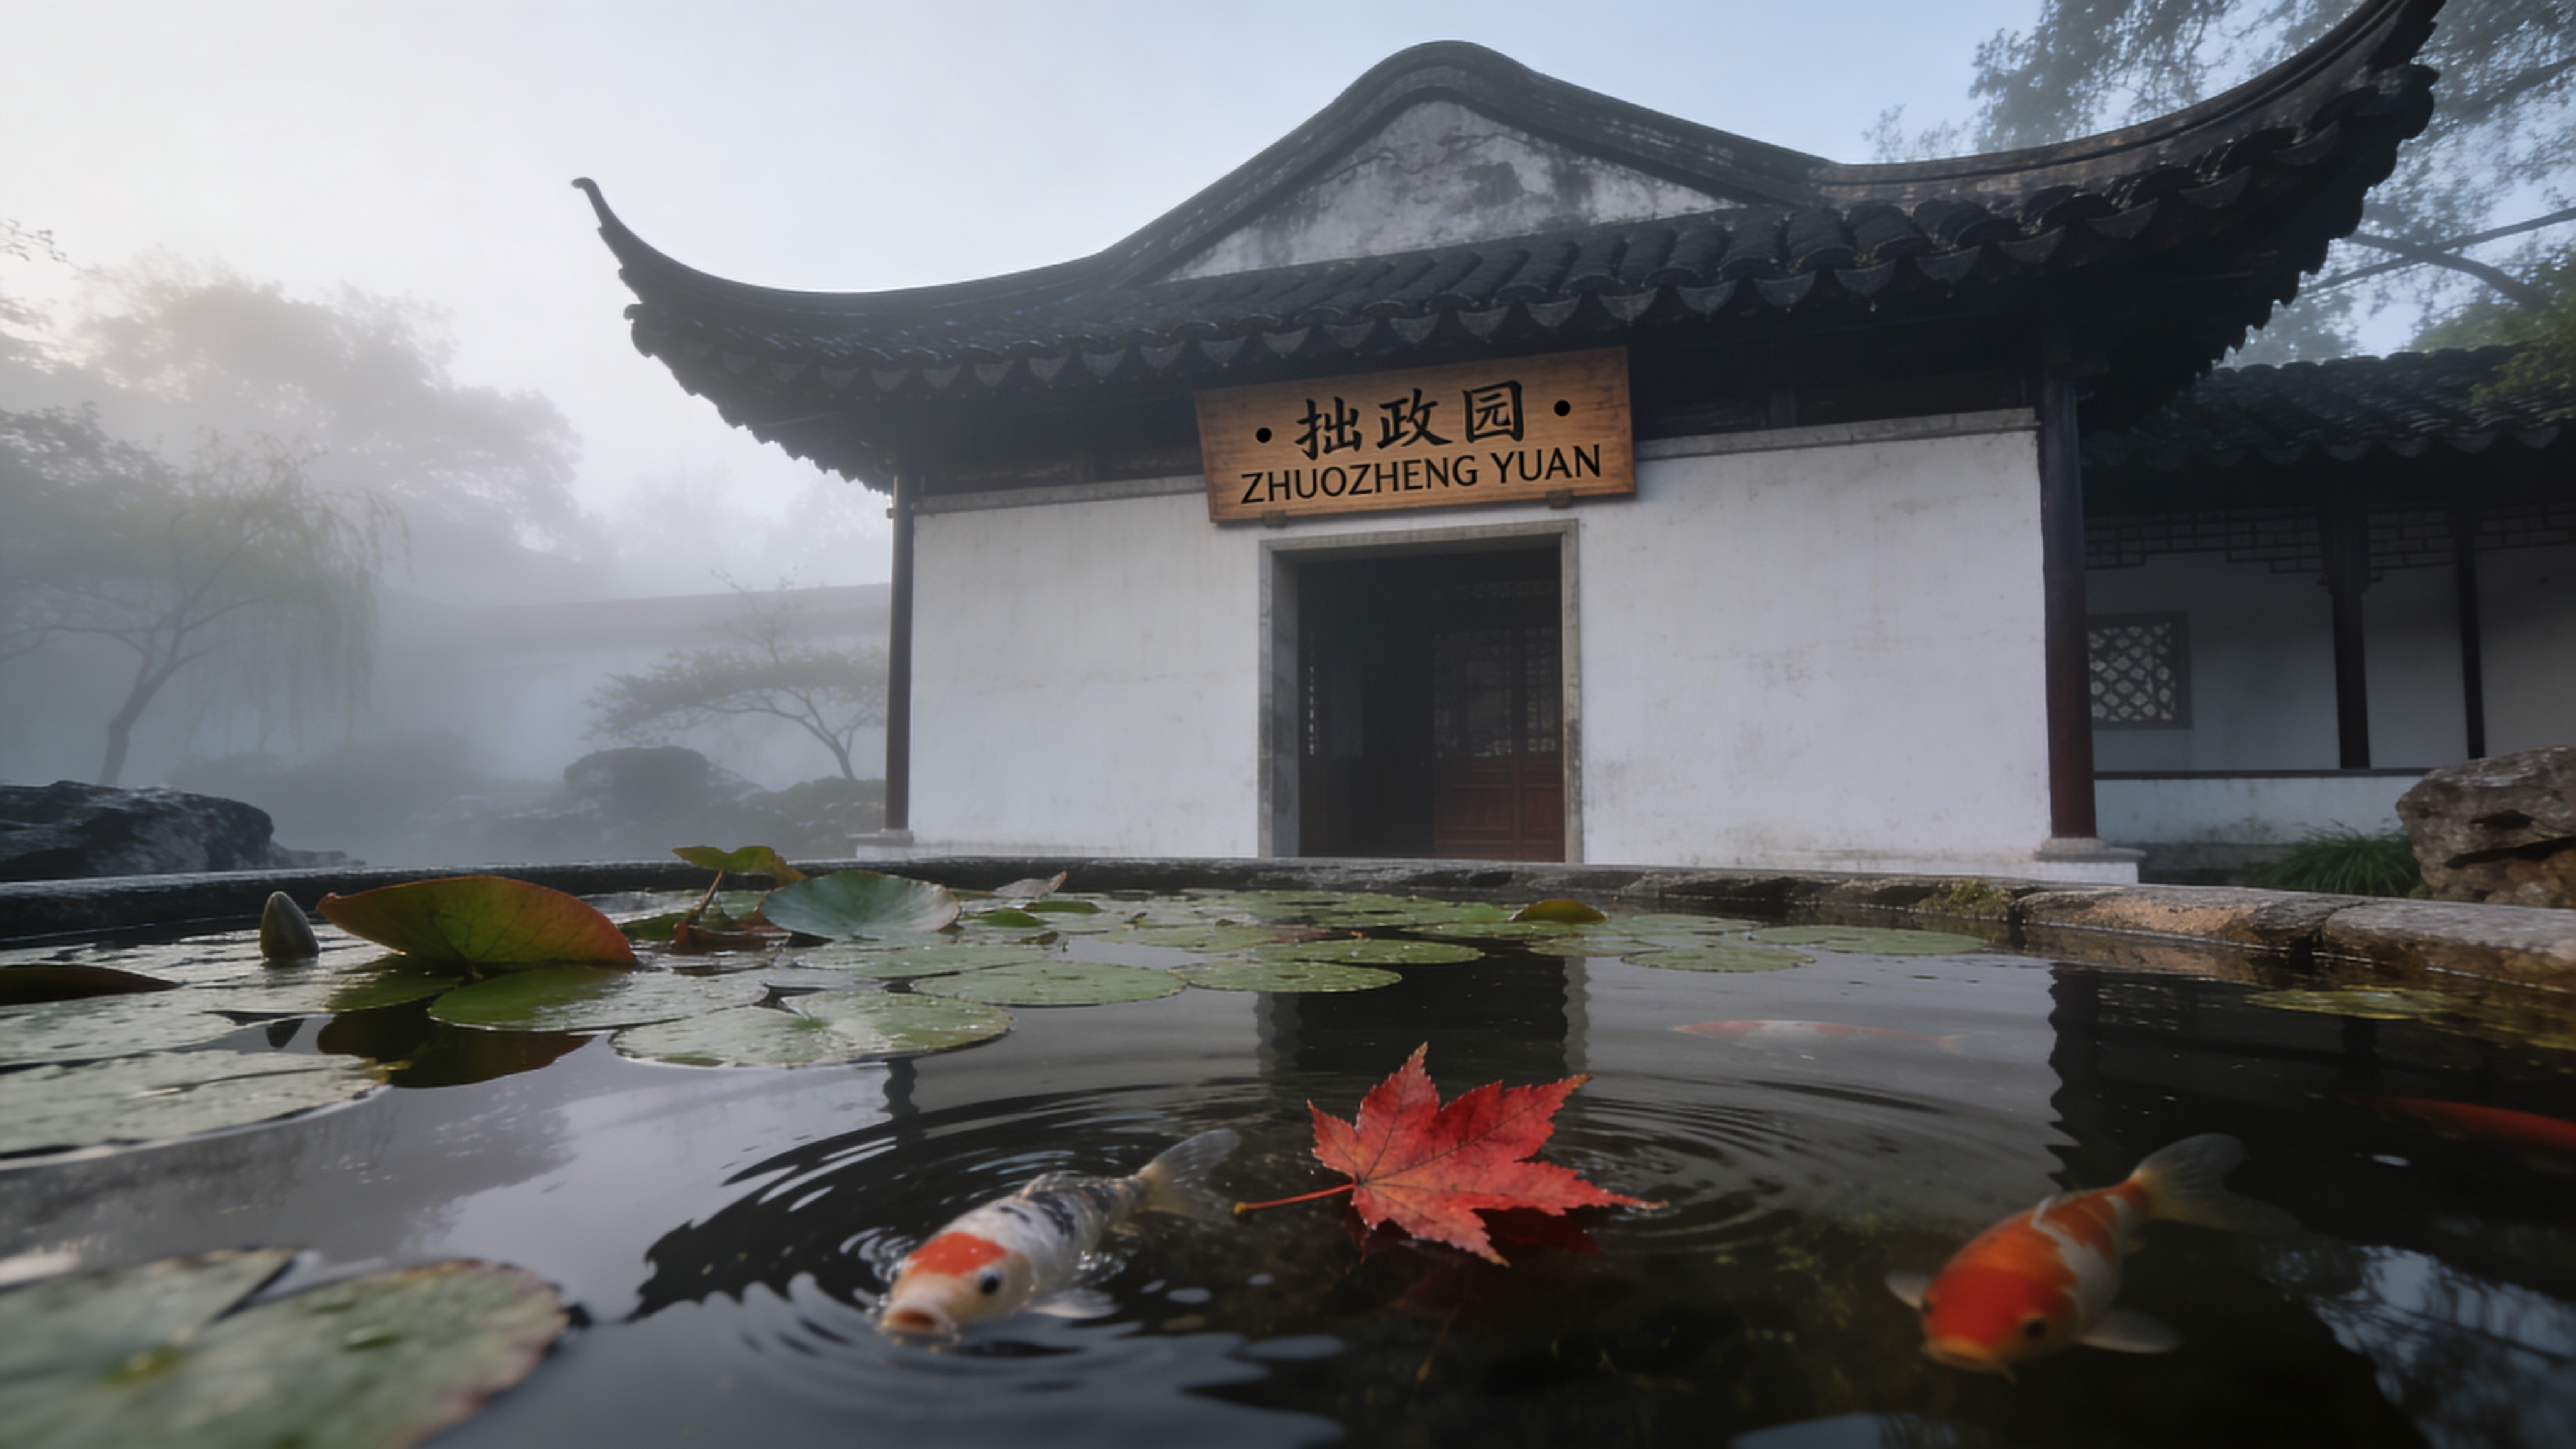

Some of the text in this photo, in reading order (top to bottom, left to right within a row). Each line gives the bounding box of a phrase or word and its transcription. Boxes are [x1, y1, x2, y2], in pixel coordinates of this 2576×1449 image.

[1294, 380, 1525, 461] 拙政园
[1241, 444, 1601, 504] ZHUOZHENG YUAN
